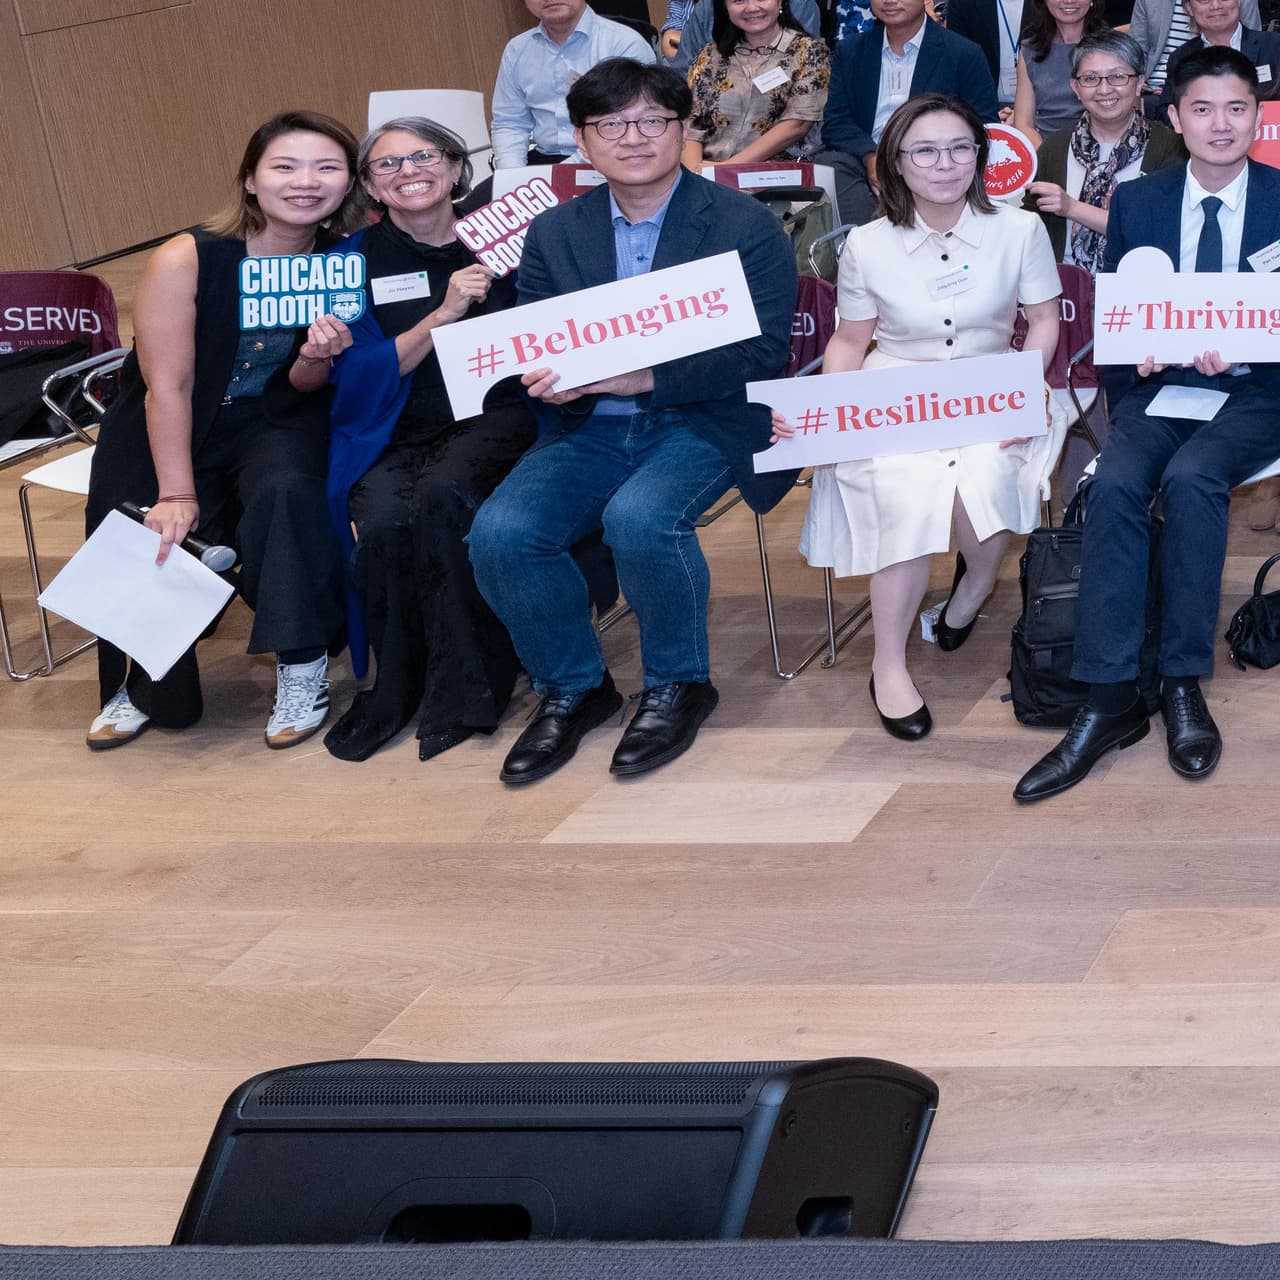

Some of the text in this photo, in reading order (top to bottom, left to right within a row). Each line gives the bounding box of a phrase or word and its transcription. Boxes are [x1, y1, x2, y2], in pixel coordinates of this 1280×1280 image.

[455, 179, 559, 250] CHICAGO
[241, 254, 364, 293] CHICAGO
[479, 226, 529, 276] BOO
[0, 306, 102, 335] SERVED
[243, 294, 326, 329] BOOTH
[467, 287, 729, 379] #Belonging
[795, 389, 1026, 436] #Resilience
